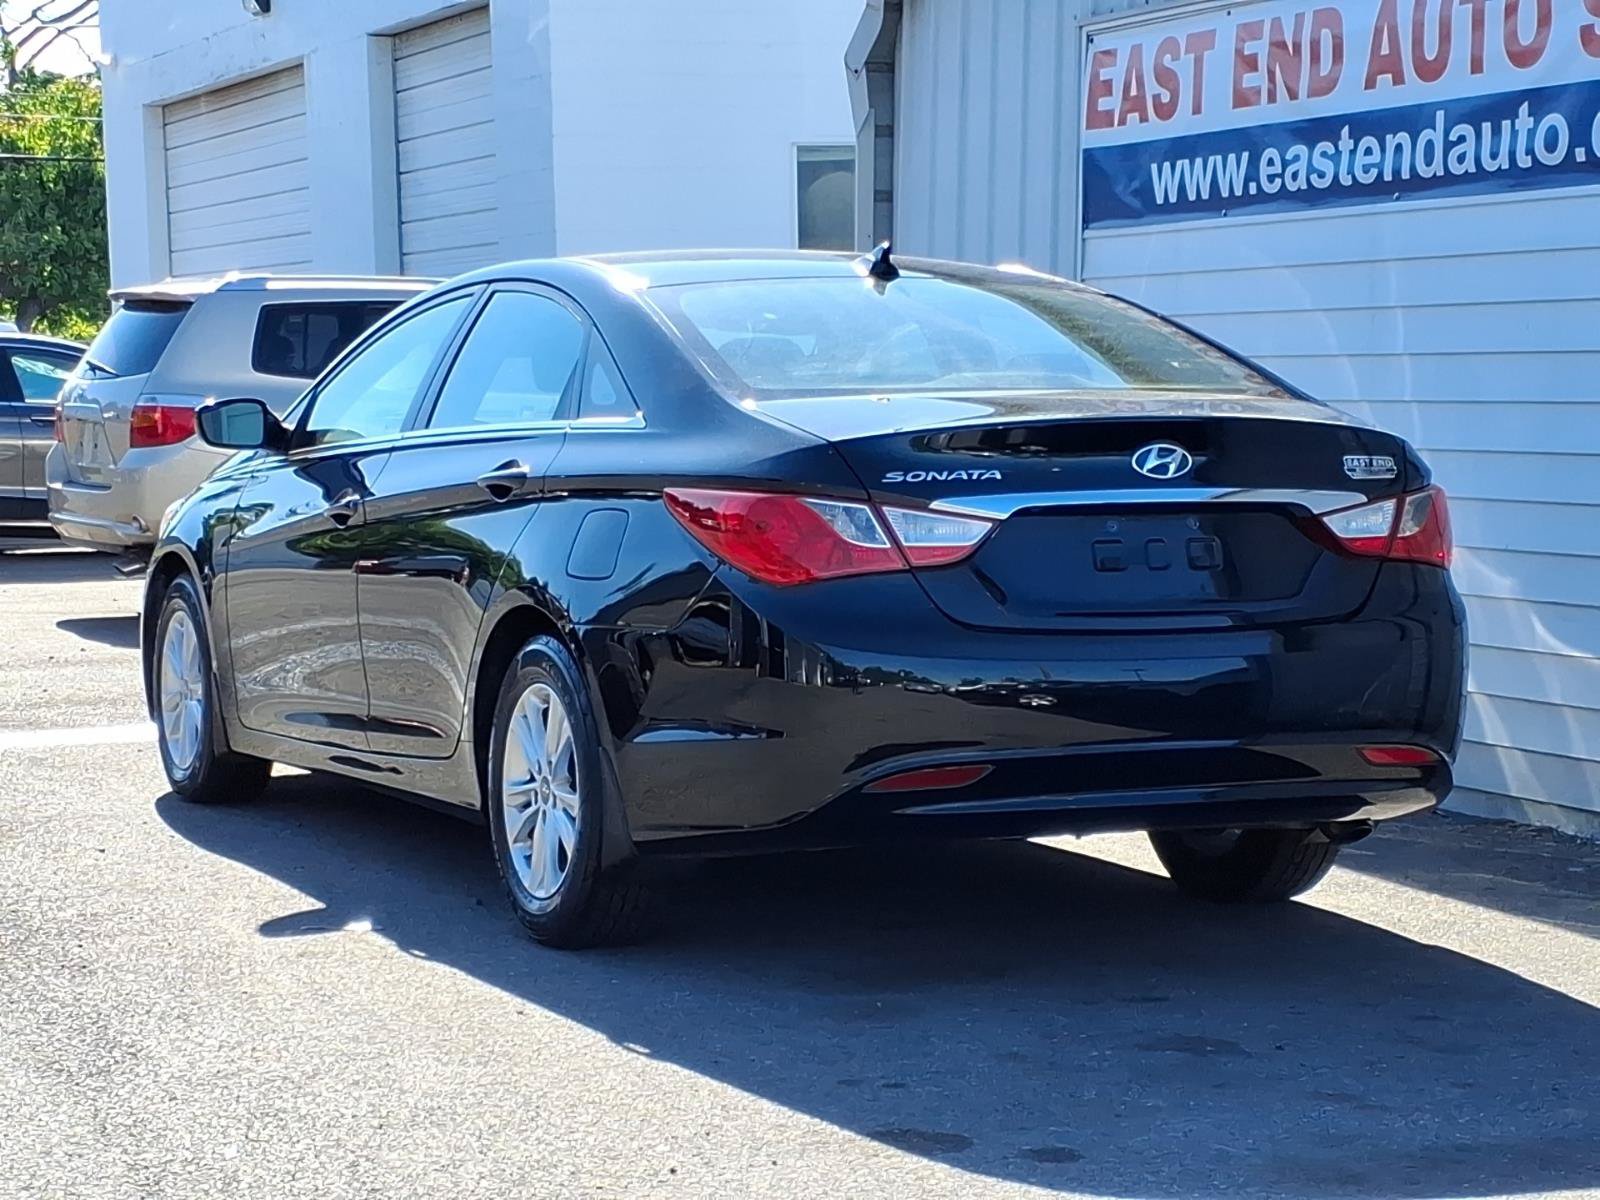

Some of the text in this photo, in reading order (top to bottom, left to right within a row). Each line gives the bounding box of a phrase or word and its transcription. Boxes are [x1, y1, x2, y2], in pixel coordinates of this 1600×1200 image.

[1085, 28, 1217, 131] EAST
[1232, 9, 1345, 110] END
[1364, 0, 1553, 91] AUTO
[1151, 100, 1600, 205] www.eastendauto.
[881, 469, 1002, 482] SONATA
